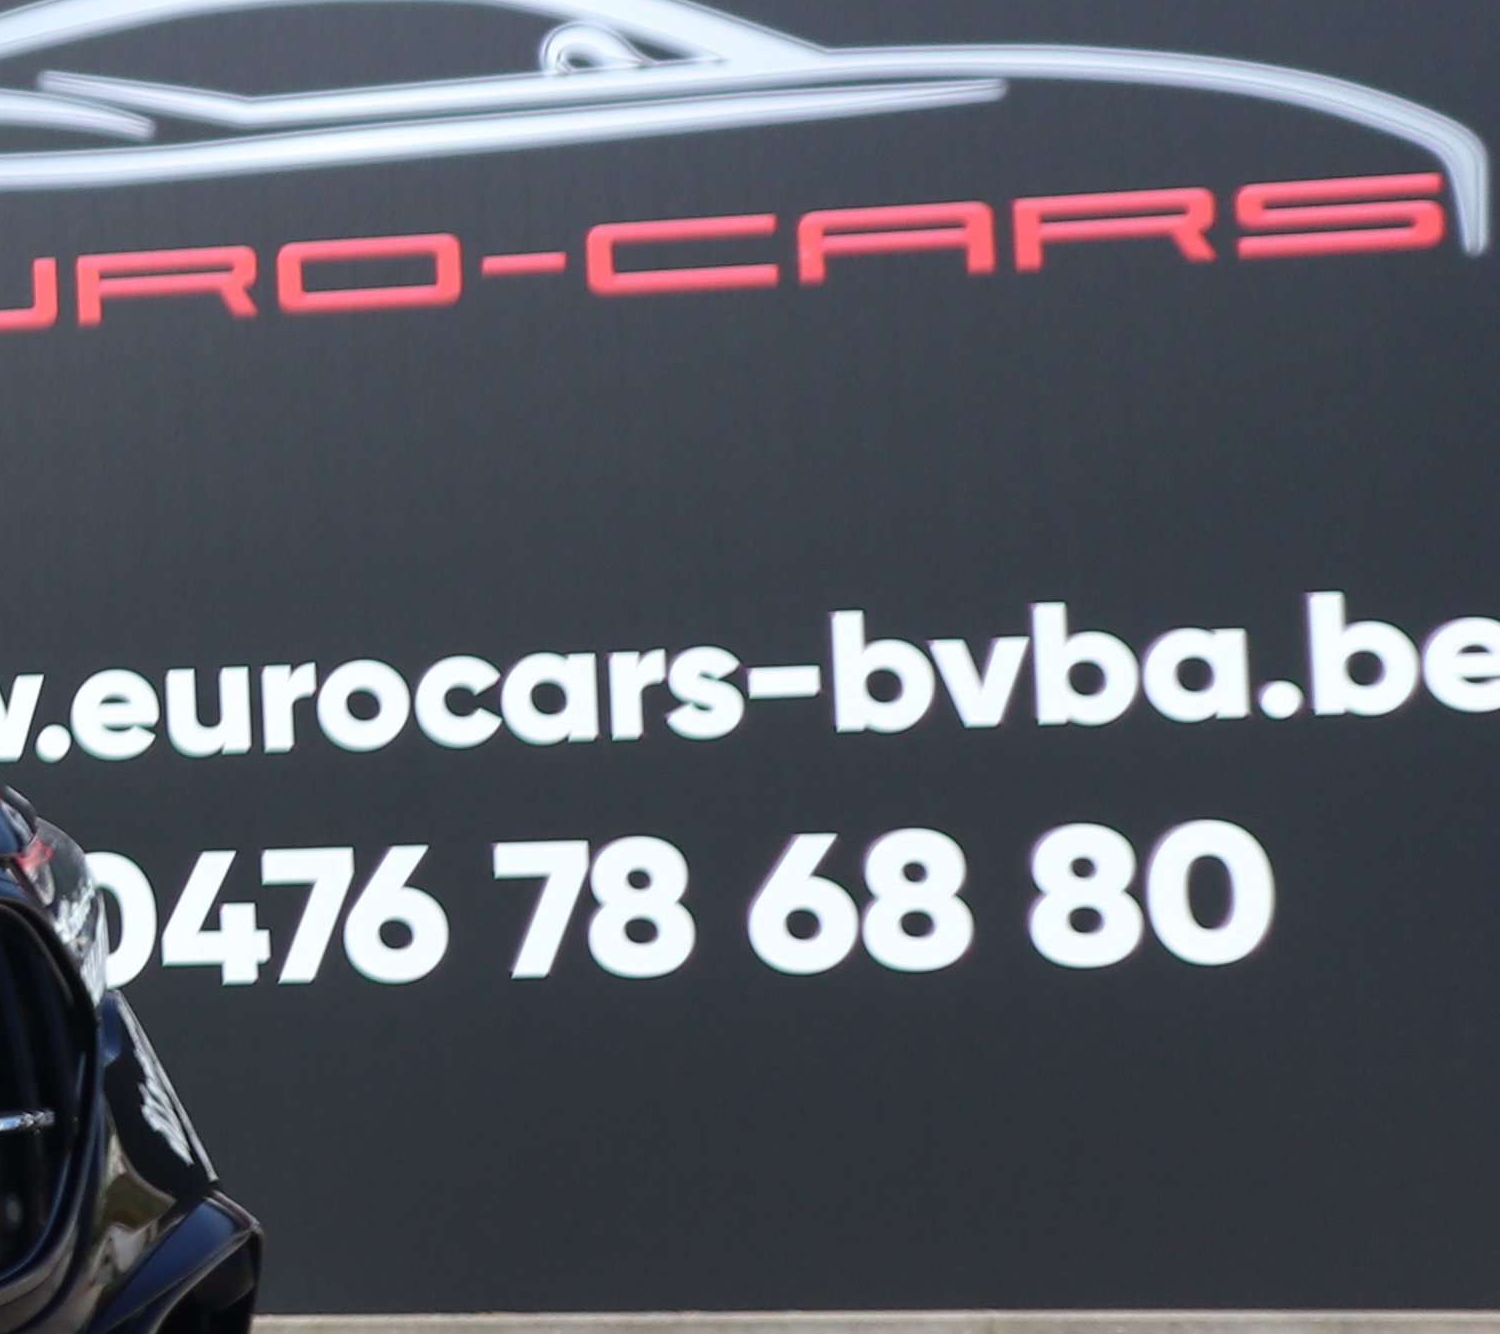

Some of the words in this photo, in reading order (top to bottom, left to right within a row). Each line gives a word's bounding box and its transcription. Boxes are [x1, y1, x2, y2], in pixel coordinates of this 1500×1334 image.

[84, 845, 449, 991] 0476
[494, 836, 695, 978] 78
[748, 828, 974, 974] 68
[1029, 819, 1274, 968] 80
